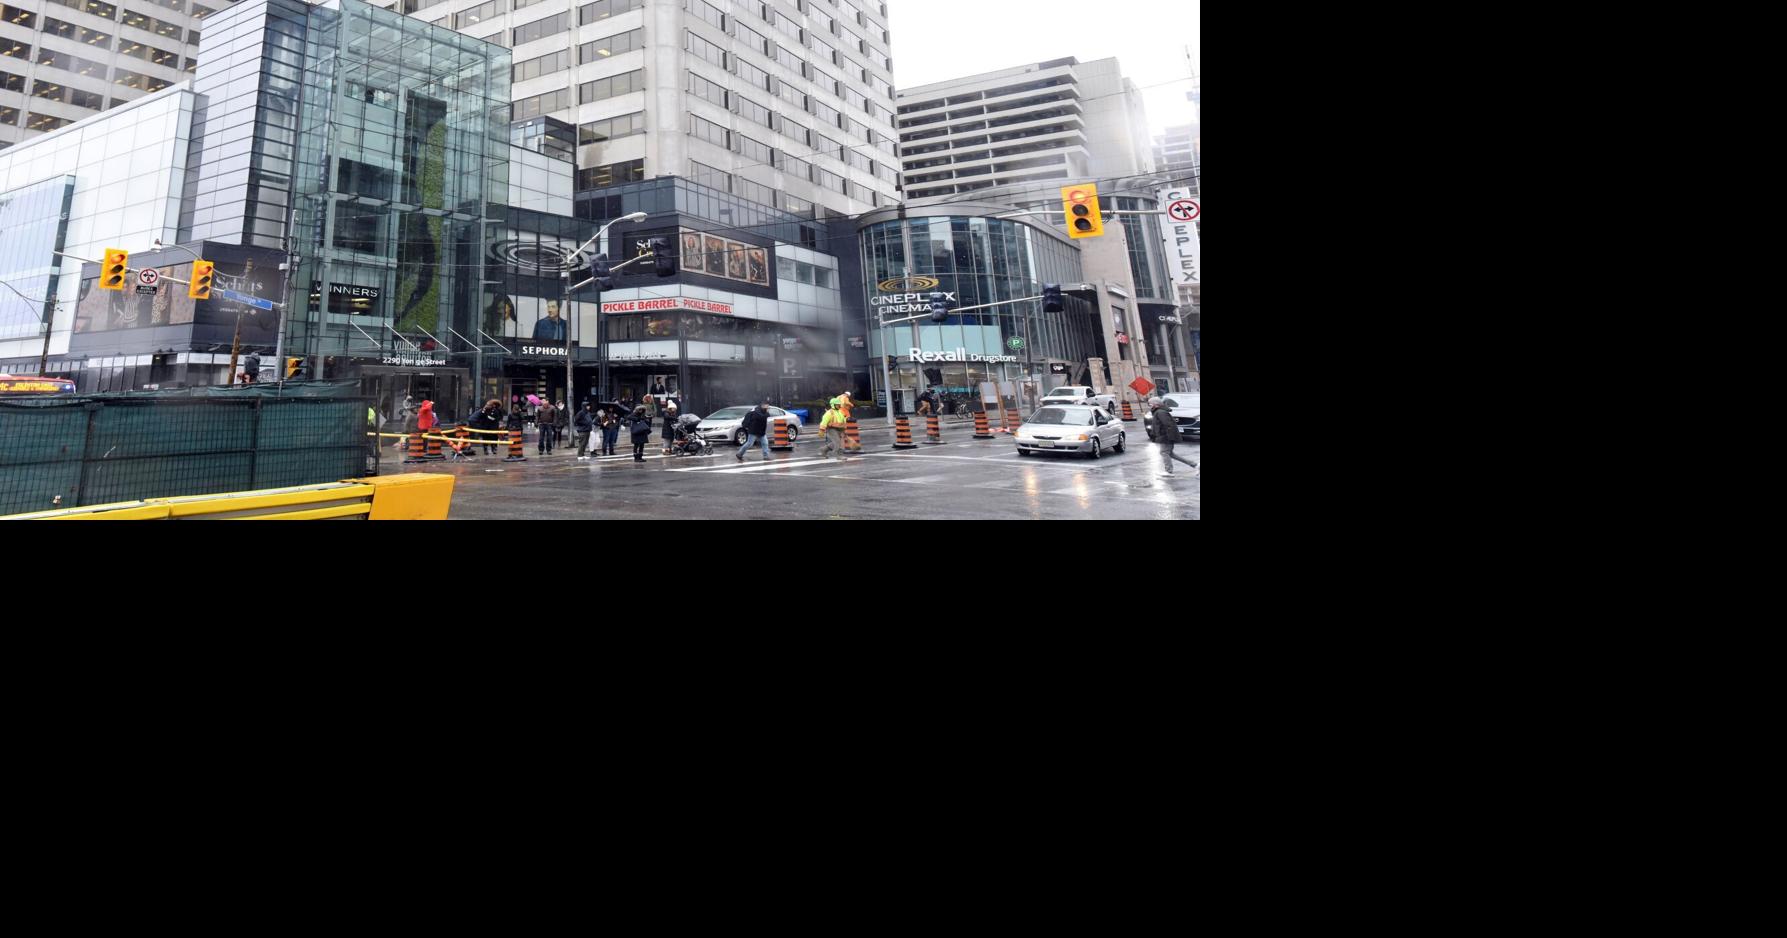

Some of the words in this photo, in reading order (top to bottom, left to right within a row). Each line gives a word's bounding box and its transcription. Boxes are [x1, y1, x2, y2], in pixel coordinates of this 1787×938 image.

[1167, 191, 1198, 282] CEPLEX
[603, 303, 635, 312] PICKLE
[638, 299, 678, 309] BARREL
[870, 291, 956, 306] CINEPLX
[683, 299, 706, 309] PICKLE
[707, 303, 732, 313] BARREL
[879, 303, 933, 314] CINEMA
[908, 347, 966, 364] Rexall
[970, 353, 1017, 363] Drugstore
